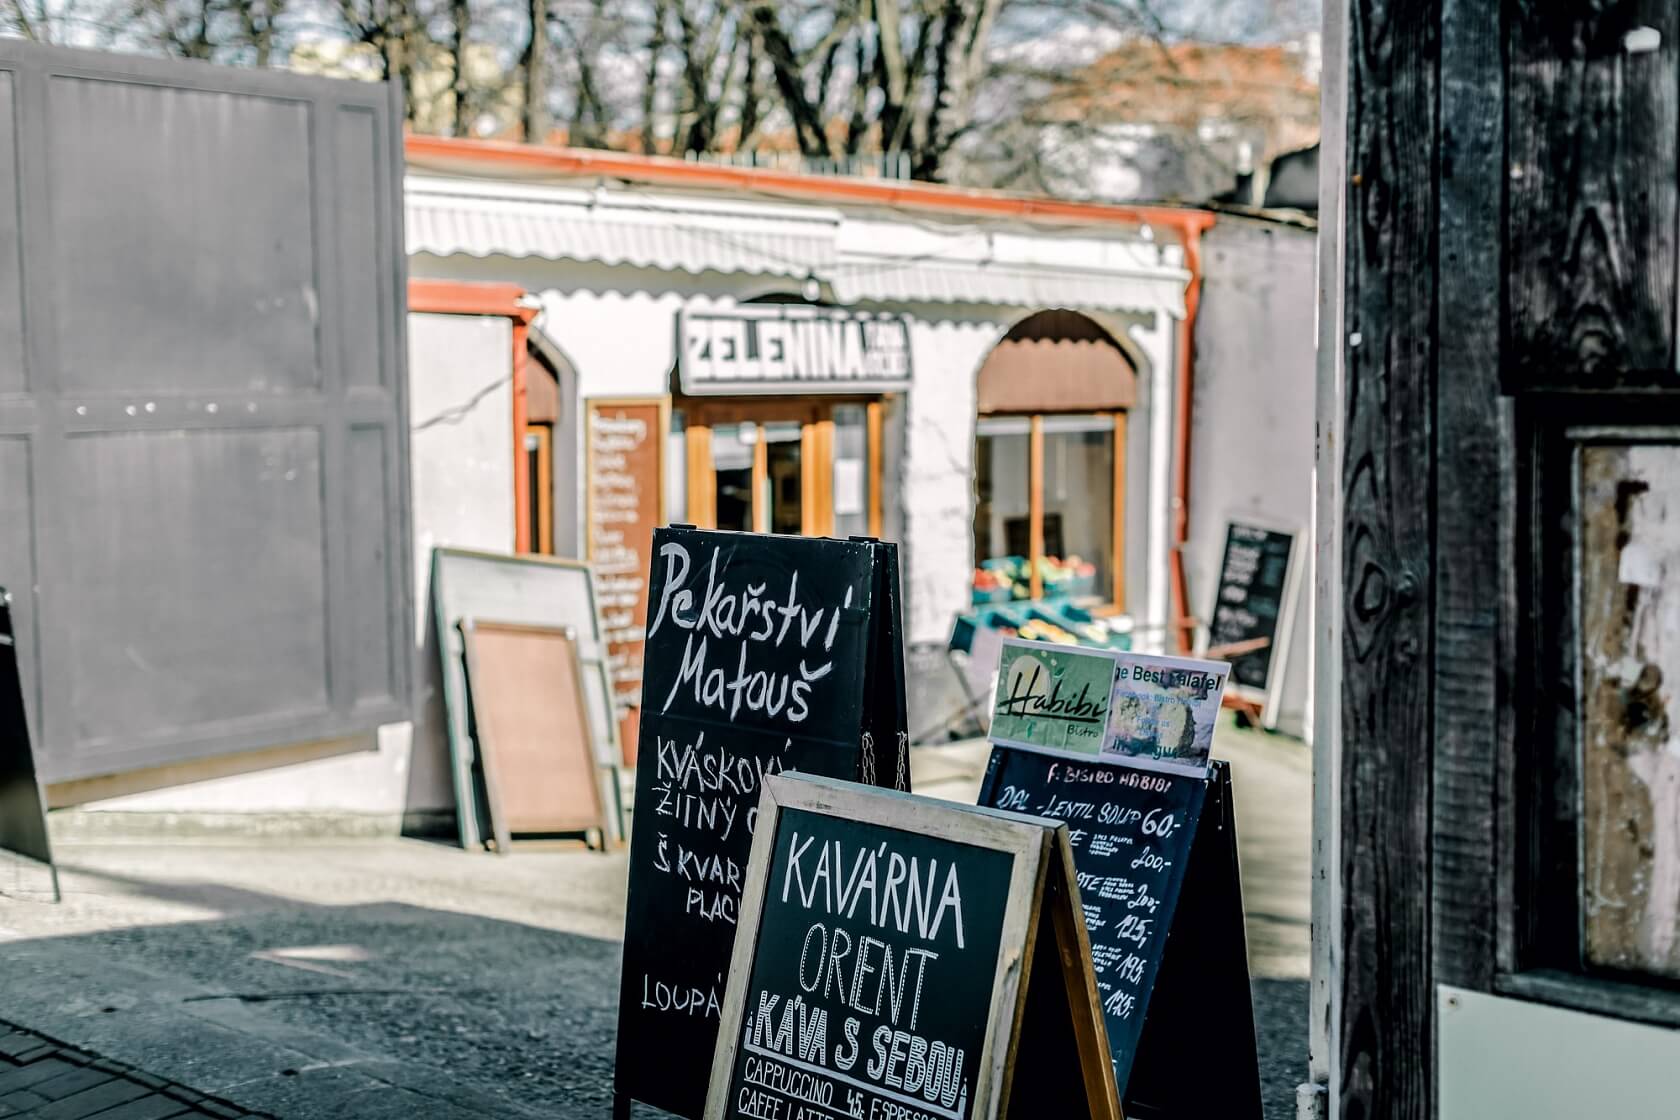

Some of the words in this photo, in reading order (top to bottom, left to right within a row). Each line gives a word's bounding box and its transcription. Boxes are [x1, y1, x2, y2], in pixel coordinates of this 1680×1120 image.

[689, 320, 865, 378] ZELENINA
[648, 542, 852, 651] Pekařství
[661, 632, 832, 722] Matouš
[998, 665, 1108, 719] Habibi
[1133, 666, 1165, 684] Best
[1067, 725, 1099, 738] Bistro
[1119, 772, 1172, 793] HABIBI
[782, 832, 965, 949] KAVÁRNA
[753, 990, 827, 1065] KÁVA
[835, 1017, 860, 1070] S
[867, 1025, 964, 1107] SEBOU
[745, 1057, 833, 1107] CAPPUCCINO
